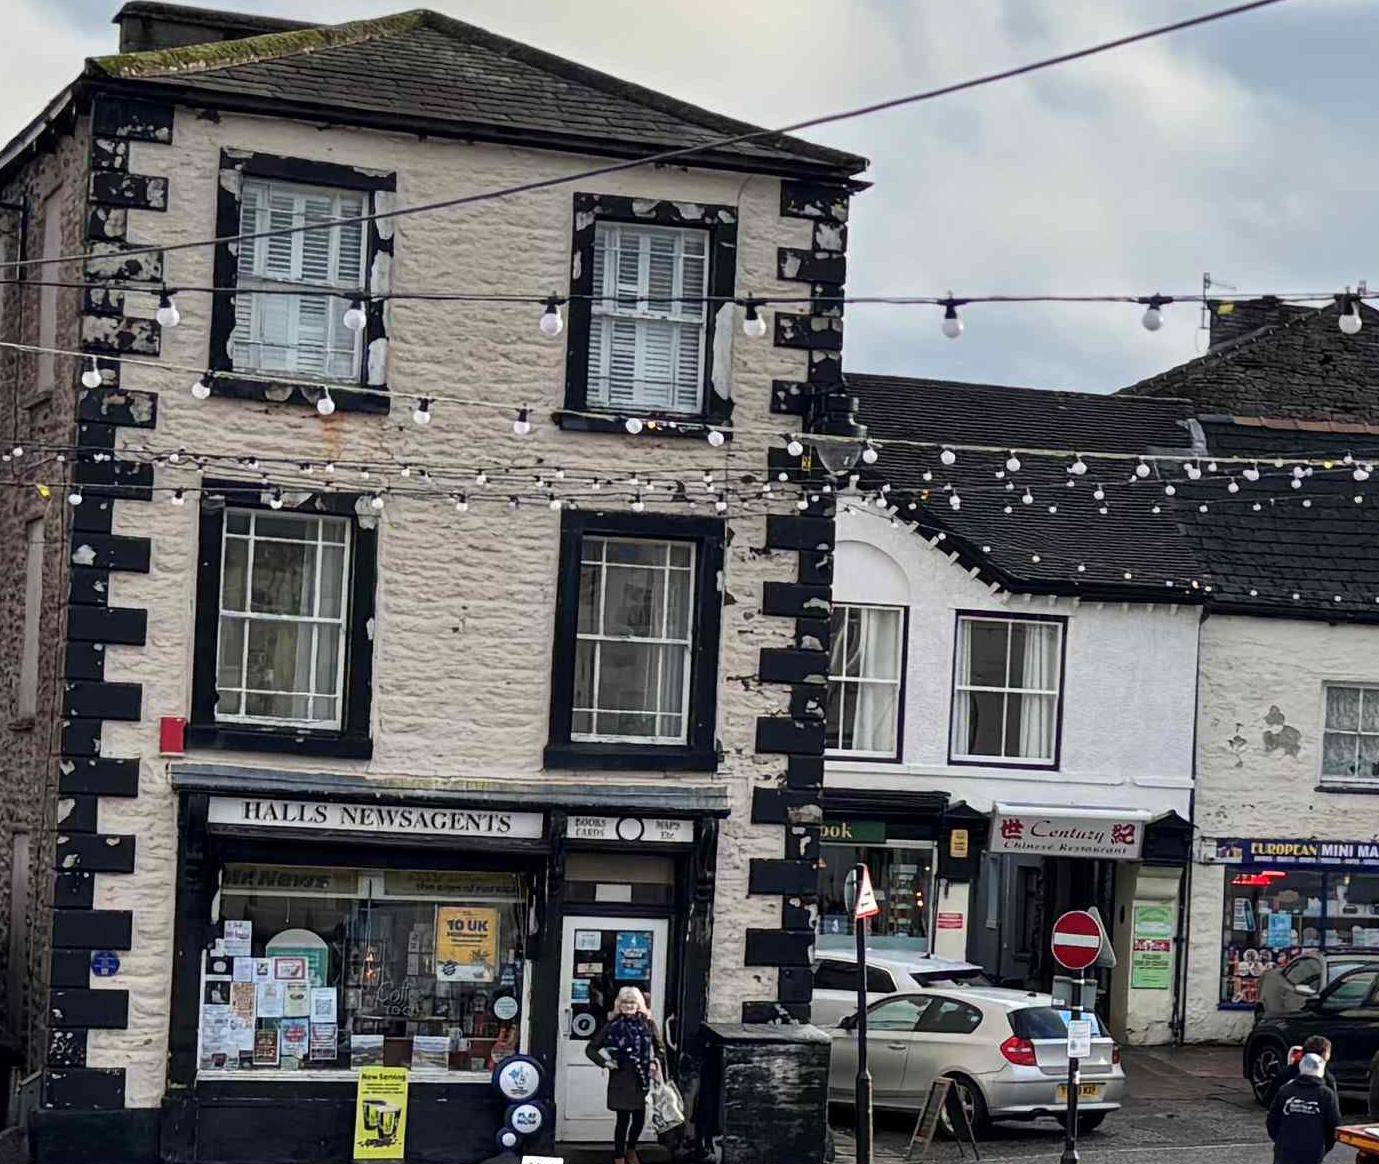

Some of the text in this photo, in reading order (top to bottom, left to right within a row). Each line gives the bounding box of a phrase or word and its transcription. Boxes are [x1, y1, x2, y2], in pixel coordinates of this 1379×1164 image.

[243, 801, 512, 833] HALLS NEWSAGENTS
[575, 818, 606, 827] BOOKS
[1000, 818, 1024, 840] 世
[1031, 819, 1105, 845] Century
[1003, 840, 1127, 855] Chinese Restaurant
[1251, 842, 1317, 856] EUROPEAN
[1321, 843, 1354, 857] MINI
[447, 919, 489, 932] 10 UK
